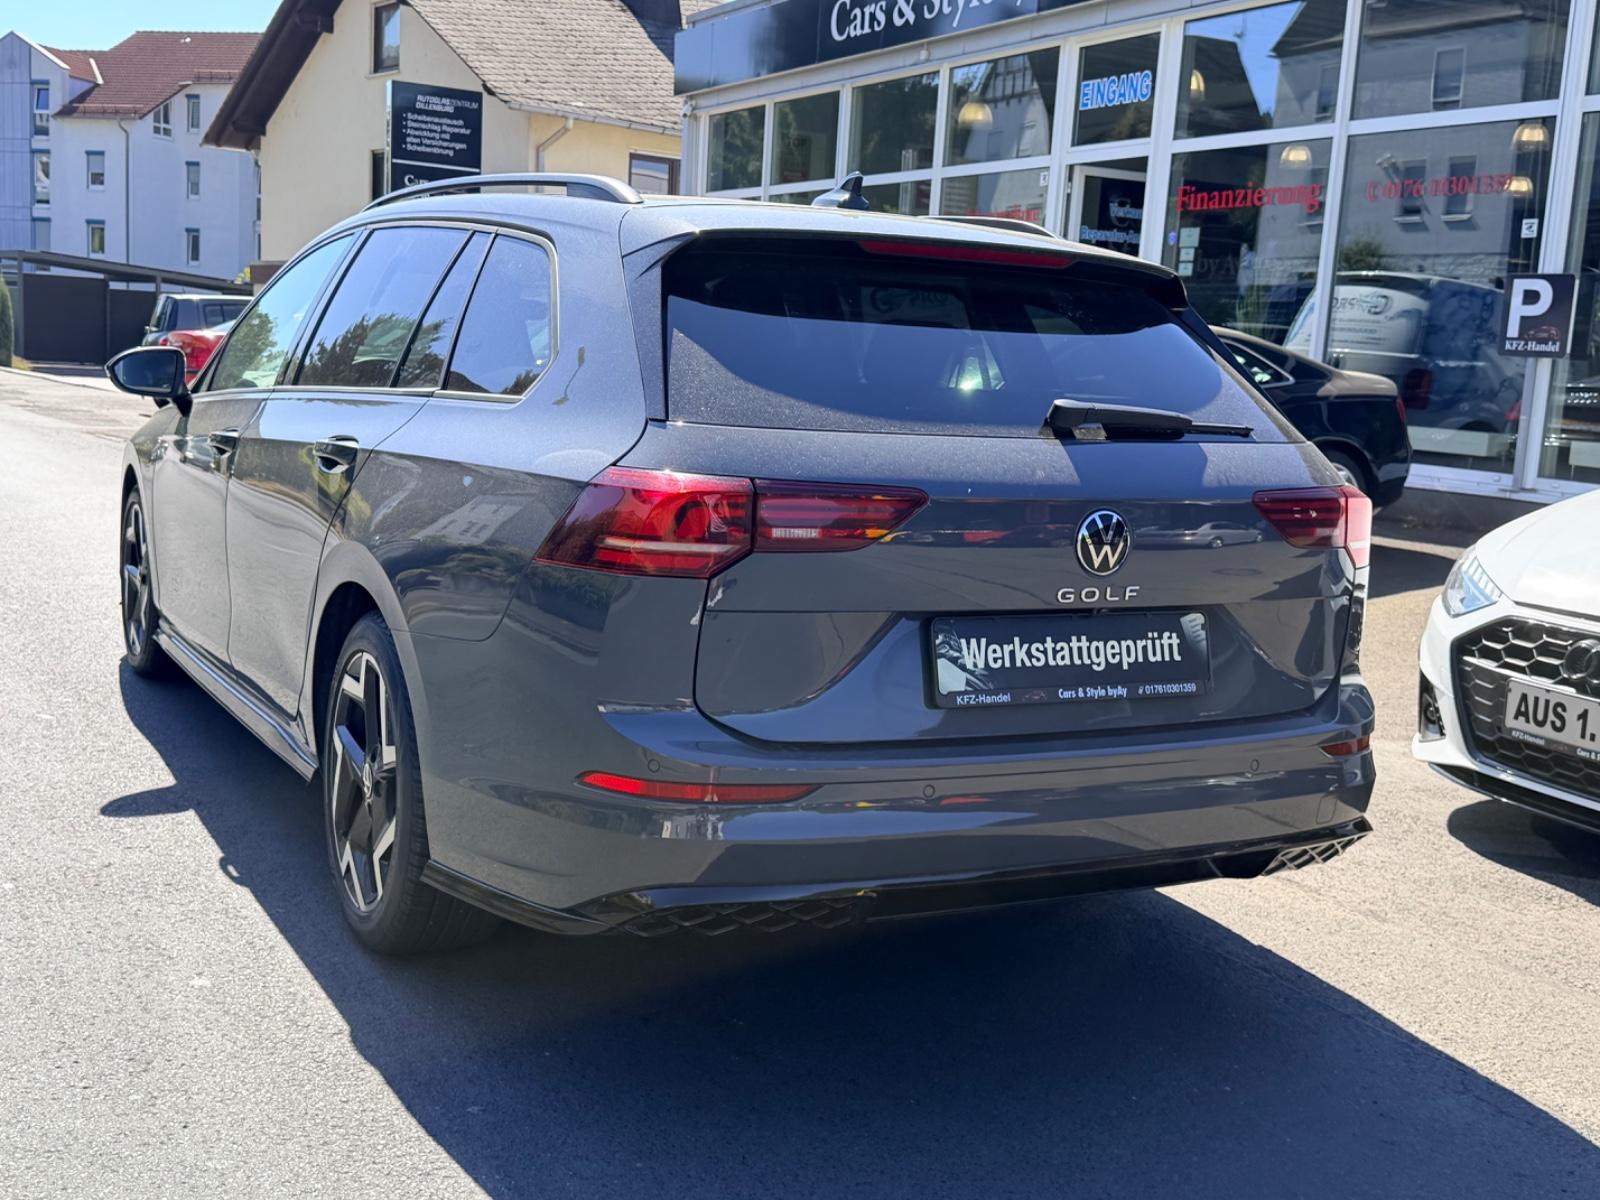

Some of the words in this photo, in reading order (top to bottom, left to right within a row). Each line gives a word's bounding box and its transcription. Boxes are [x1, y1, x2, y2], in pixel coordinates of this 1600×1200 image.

[831, 0, 887, 41] Cars
[893, 0, 916, 27] &
[1080, 70, 1152, 110] EINGANG
[416, 102, 455, 113] DILLENBURG
[442, 125, 472, 135] Reparatur
[1176, 181, 1321, 213] Finanzierung
[1506, 278, 1554, 338] P
[1505, 339, 1561, 353] KFZ-Handel
[1057, 586, 1141, 603] GOLF
[959, 631, 1182, 671] Werkstattgeprüft
[956, 692, 1011, 705] KFZ-Handel
[1058, 688, 1076, 699] Cars
[1078, 687, 1085, 698] &
[1086, 686, 1106, 699] Style
[1513, 692, 1567, 733] AUS
[1576, 708, 1596, 742] 1.
